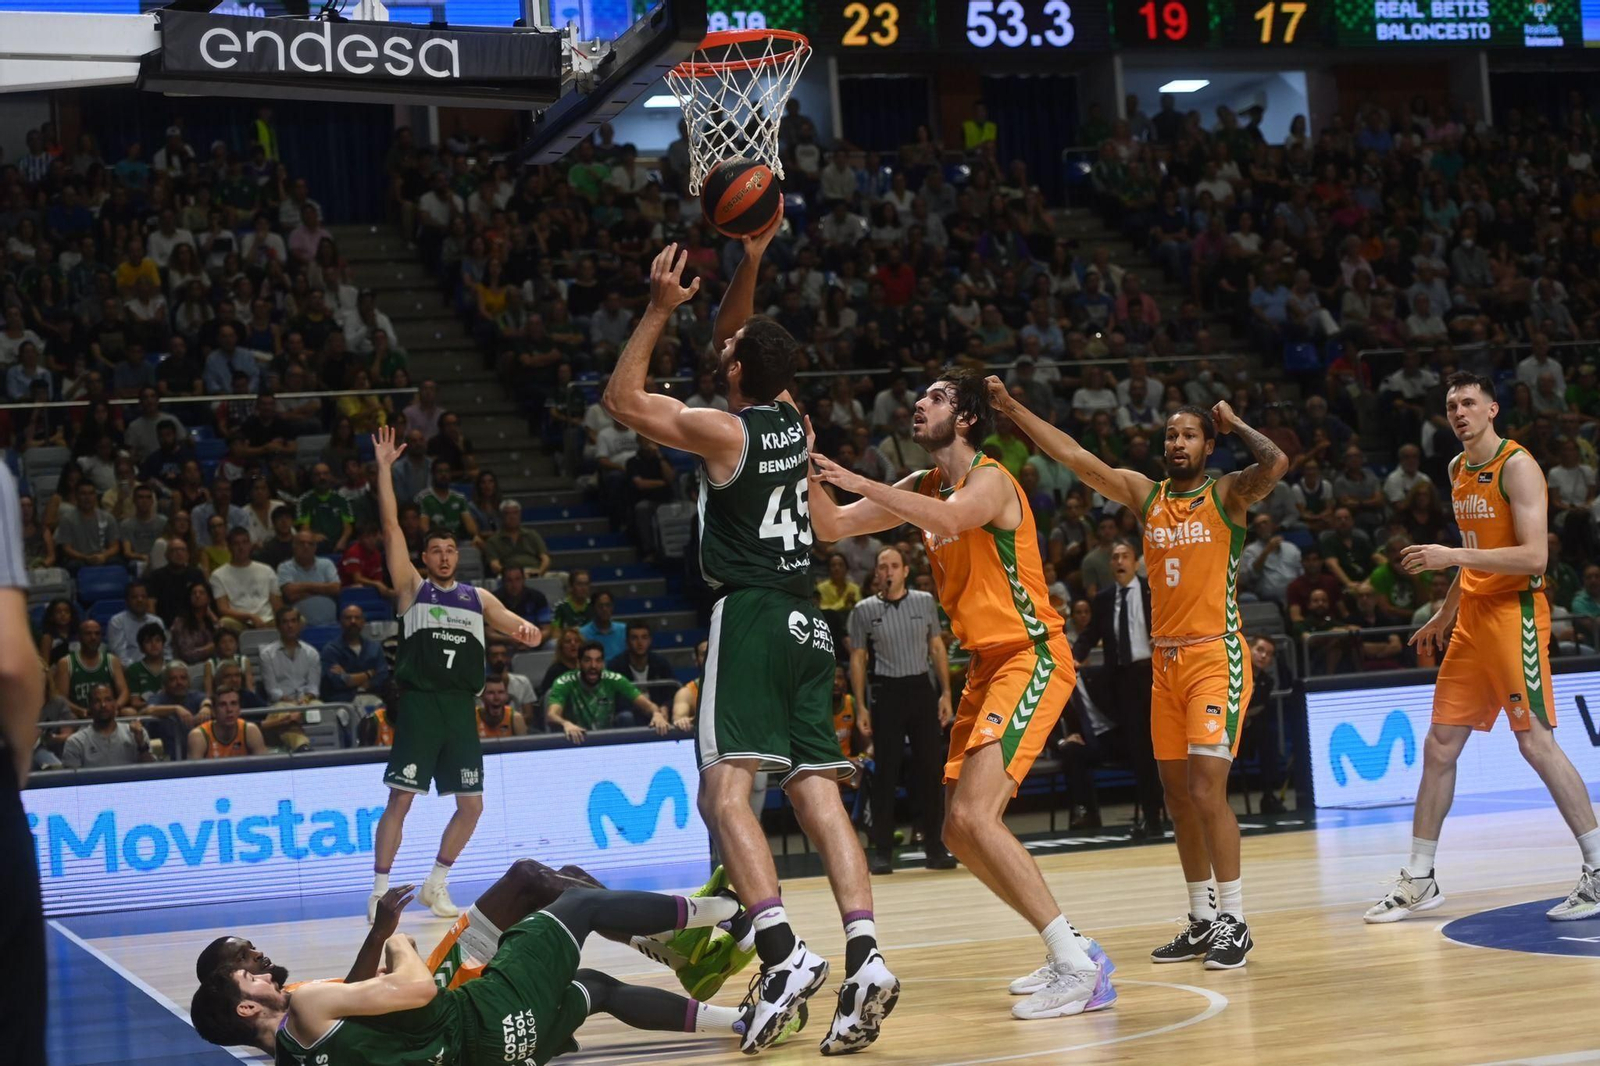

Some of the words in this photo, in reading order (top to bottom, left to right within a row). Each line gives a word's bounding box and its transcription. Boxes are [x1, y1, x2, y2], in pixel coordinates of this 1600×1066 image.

[706, 11, 767, 33] AJA
[1138, 1, 1188, 40] 19
[1375, 1, 1425, 18] REAL
[1431, 0, 1490, 18] BETIS
[841, 1, 899, 46] 23
[966, 0, 1075, 47] 53.3
[1253, 3, 1307, 43] 17
[1376, 22, 1491, 40] BALONCESTO
[199, 21, 461, 78] endesa
[1452, 494, 1494, 514] evilla.
[1165, 557, 1181, 588] 5
[432, 630, 467, 645] málaga
[443, 649, 457, 669] 7
[515, 1010, 527, 1037] SOL
[502, 1013, 517, 1062] COSTA
[517, 1038, 528, 1060] DEL
